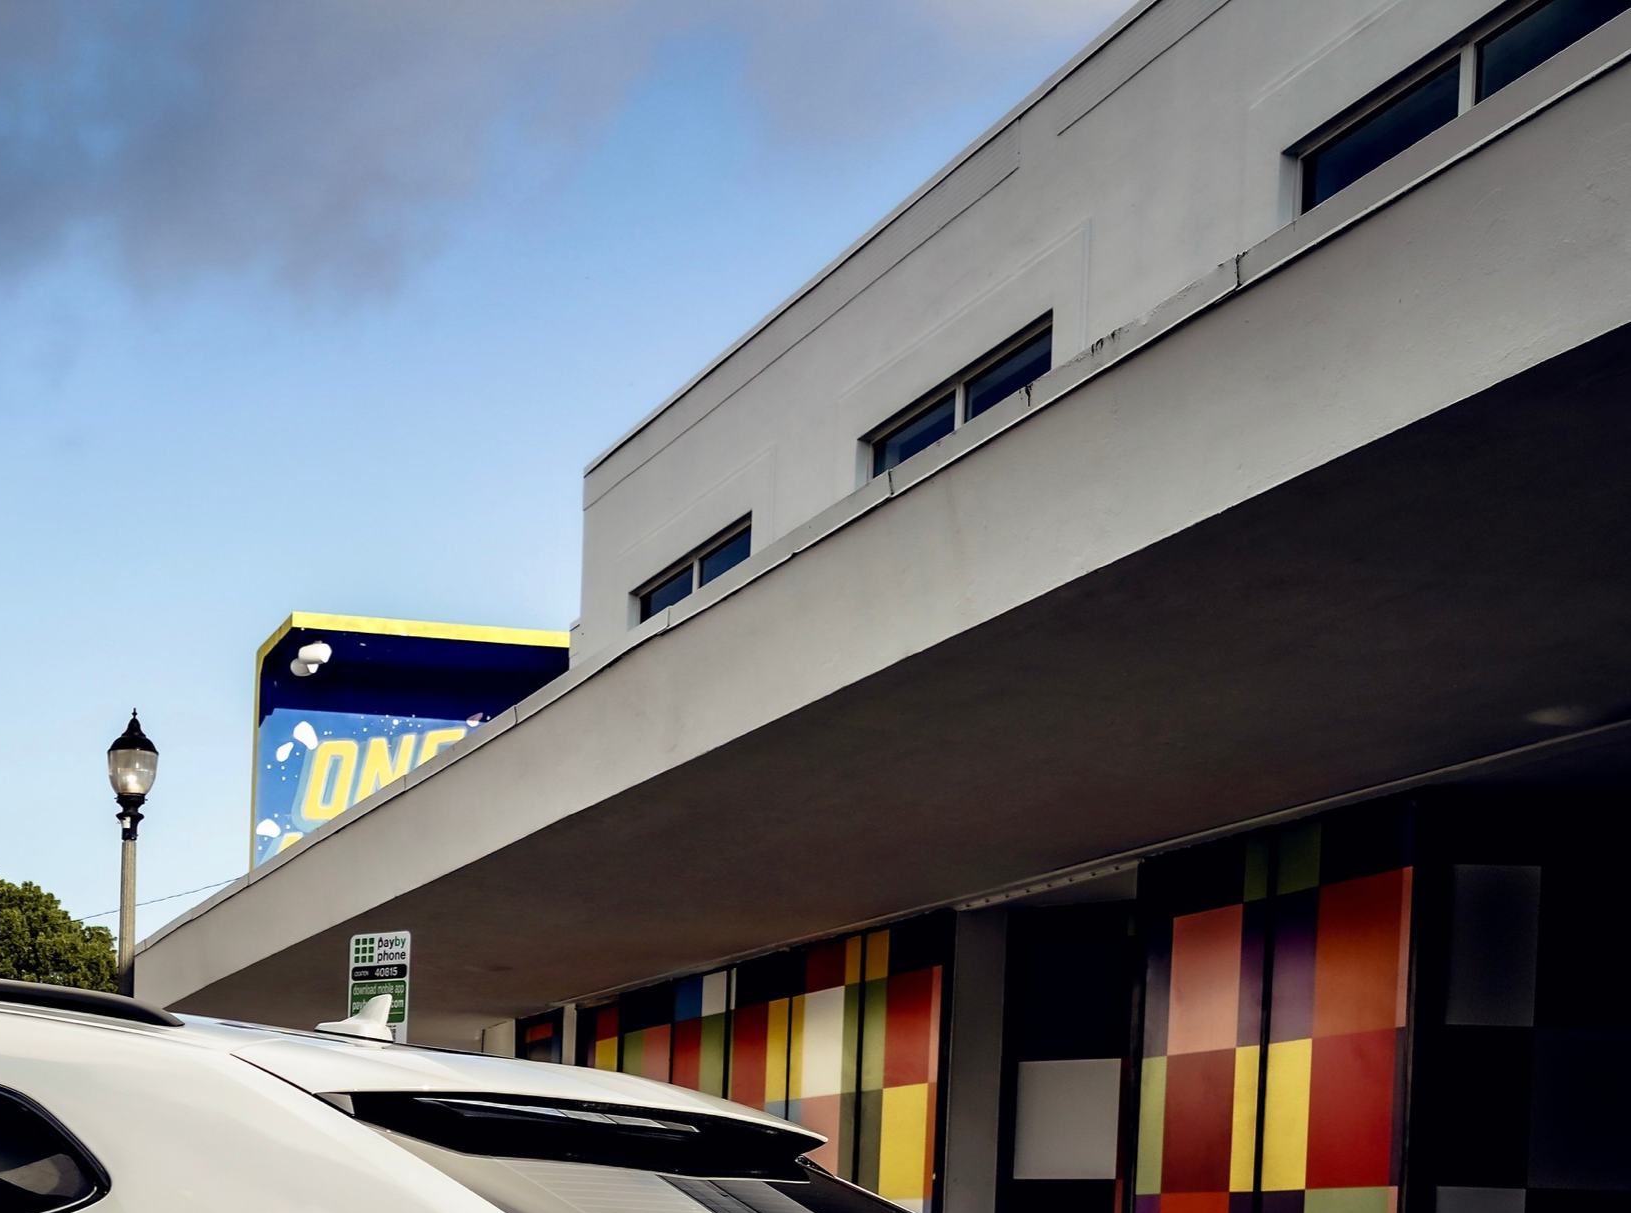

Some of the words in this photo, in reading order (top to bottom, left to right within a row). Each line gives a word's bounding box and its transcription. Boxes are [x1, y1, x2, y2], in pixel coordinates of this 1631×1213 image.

[377, 936, 406, 950] payby
[377, 950, 406, 963] phone
[353, 984, 377, 996] download
[377, 983, 394, 994] mobile
[395, 984, 405, 996] app
